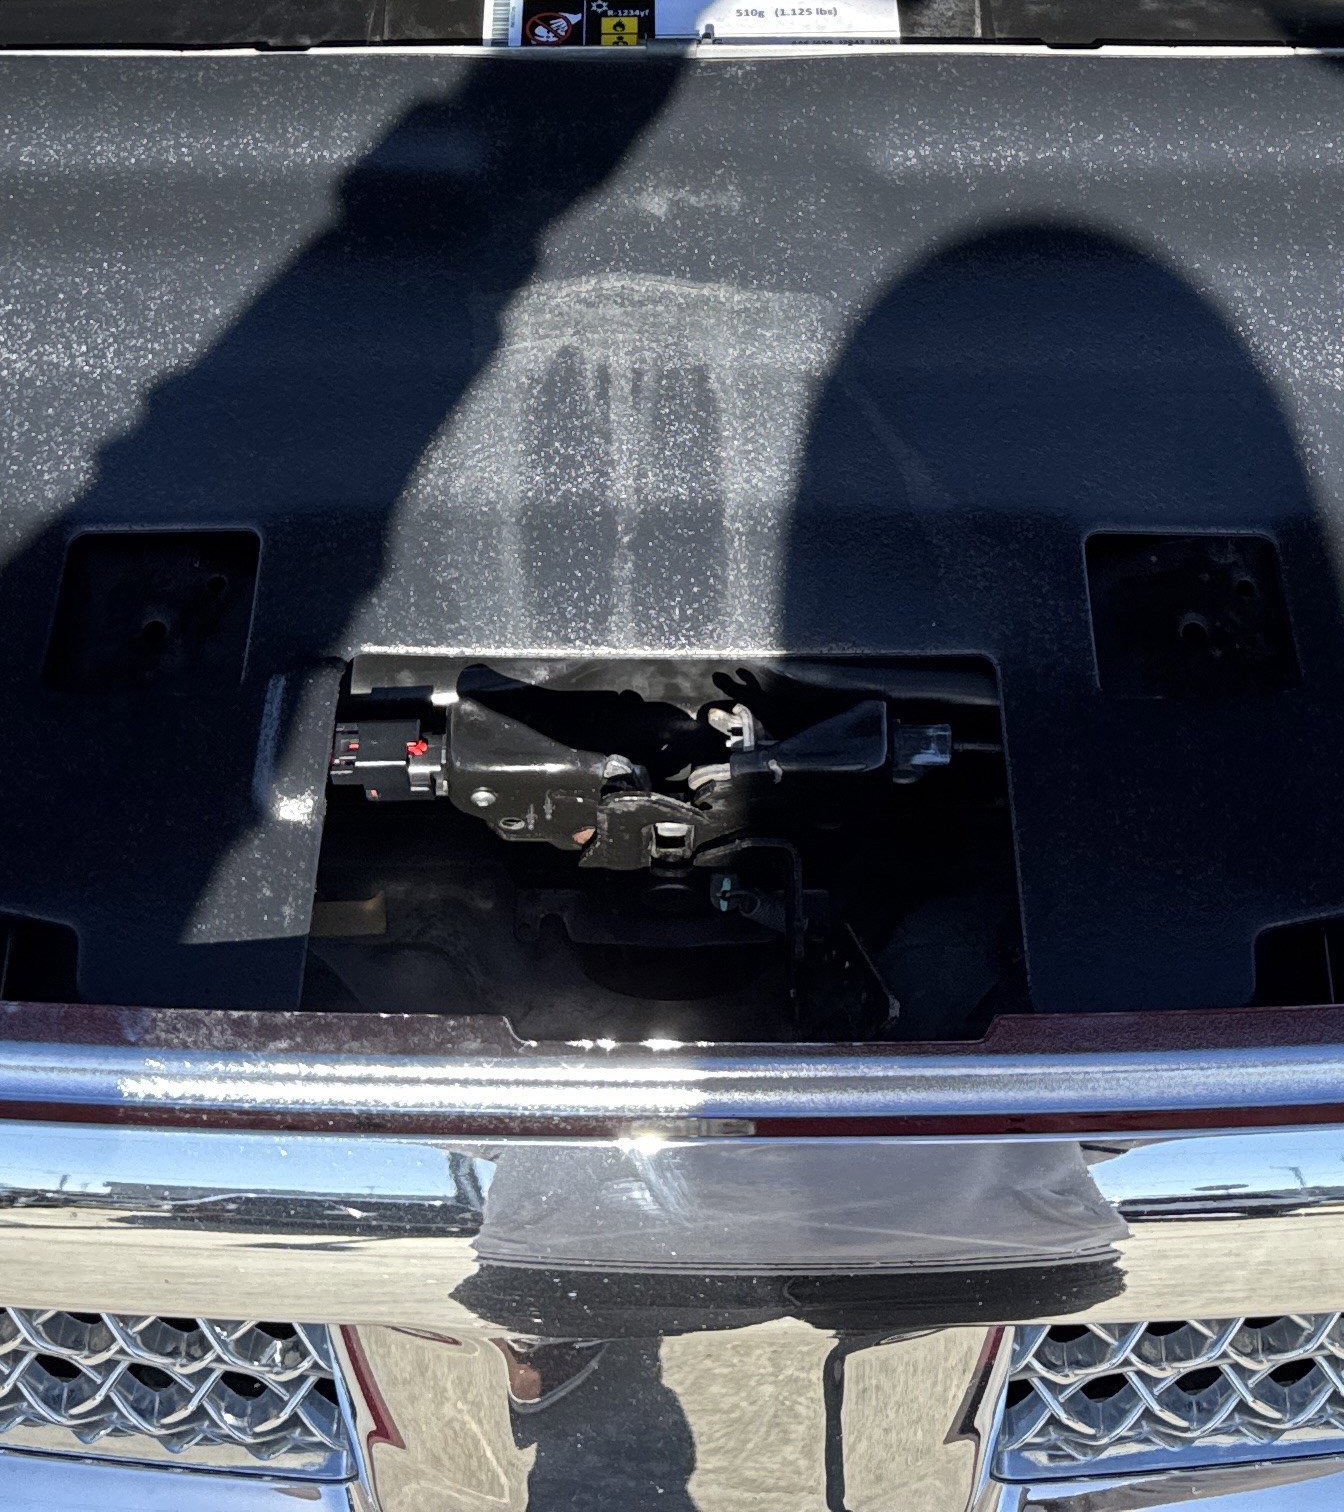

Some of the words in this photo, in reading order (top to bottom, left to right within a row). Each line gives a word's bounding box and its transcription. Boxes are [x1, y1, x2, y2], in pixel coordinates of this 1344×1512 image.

[606, 9, 649, 18] R-1234yf
[735, 8, 765, 19] 510g
[774, 7, 812, 18] (1.125
[815, 6, 838, 18] lbs)
